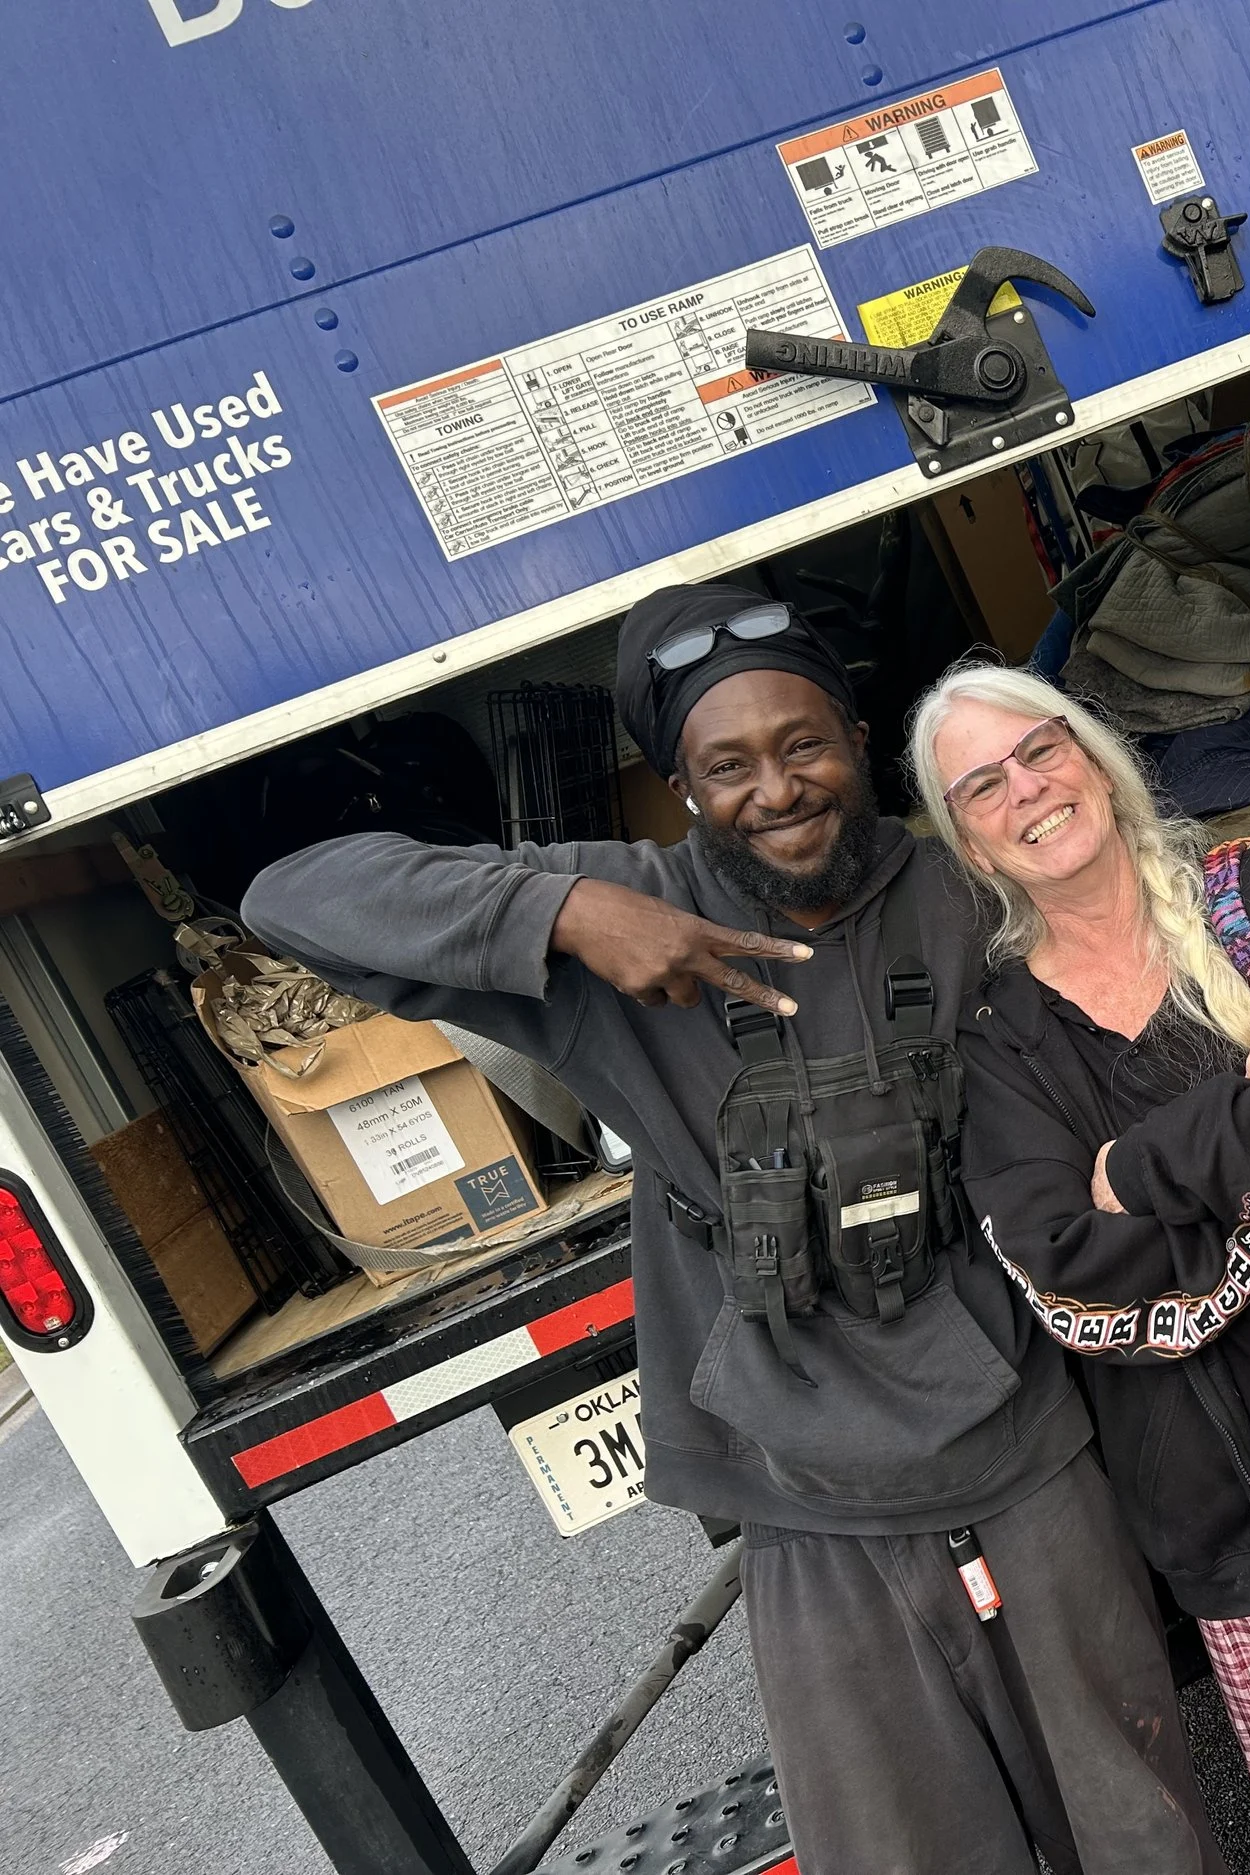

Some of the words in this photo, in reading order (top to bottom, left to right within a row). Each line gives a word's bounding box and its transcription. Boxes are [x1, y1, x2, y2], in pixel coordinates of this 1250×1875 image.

[864, 92, 947, 133] WARNING
[971, 148, 983, 157] Use
[983, 144, 997, 153] grab
[996, 137, 1017, 148] handle
[1147, 134, 1184, 154] WARNING
[917, 166, 935, 177] Driving
[935, 162, 945, 170] with
[945, 158, 957, 166] door
[957, 155, 970, 163] open
[864, 184, 886, 196] Moving
[885, 178, 900, 187] Door
[925, 187, 940, 196] Close
[939, 183, 950, 191] and
[949, 179, 962, 188] latch
[961, 175, 974, 183] door
[872, 206, 887, 215] Stand
[886, 202, 898, 210] clear
[904, 193, 924, 205] opening
[817, 227, 828, 235] Pull
[828, 222, 843, 232] strap
[853, 212, 869, 222] break
[618, 316, 638, 332] TO
[639, 306, 666, 325] USE
[667, 292, 706, 314] RAMP
[713, 326, 736, 339] CLOSE
[585, 352, 603, 364] Open
[602, 347, 617, 356] Rear
[616, 341, 633, 351] Door
[775, 340, 905, 377] WHITING
[552, 362, 573, 375] OPEN
[593, 367, 614, 380] Follow
[614, 352, 655, 372] manufacturers
[558, 376, 581, 389] LOWER
[560, 385, 574, 395] LIFT
[574, 379, 592, 390] GATE
[596, 370, 629, 387] instructions
[741, 388, 758, 398] Avoid
[757, 380, 779, 392] Serious
[779, 374, 796, 386] Injury
[752, 400, 762, 408] not
[763, 396, 778, 404] move
[778, 389, 793, 399] truck
[792, 385, 805, 394] with
[805, 381, 821, 390] ramp
[569, 398, 600, 414] RELEASE
[611, 413, 623, 421] Pull
[623, 409, 633, 417] out
[633, 397, 668, 414] completely
[745, 411, 753, 419] or
[753, 402, 779, 416] unlocked
[755, 425, 764, 433] Do
[764, 422, 774, 430] not
[773, 415, 793, 426] exceed
[793, 410, 807, 419] 1000
[806, 407, 816, 415] lbs.
[824, 400, 839, 410] ramp
[434, 412, 484, 437] TOWING
[578, 422, 597, 433] PULL
[0, 479, 15, 513] e
[16, 431, 151, 500] Have
[151, 371, 283, 449] Used
[587, 440, 608, 452] HOOK
[595, 457, 620, 470] CHECK
[646, 467, 662, 476] level
[661, 459, 685, 472] ground
[603, 473, 634, 489] POSITION
[0, 512, 81, 570] ars
[86, 487, 134, 530] &
[126, 435, 292, 513] Trucks
[36, 536, 148, 604] FOR
[148, 487, 271, 564] SALE
[347, 1096, 375, 1112] 6100
[381, 1083, 405, 1097] TAN
[354, 1112, 390, 1131] 48mm
[388, 1106, 399, 1116] X
[398, 1095, 423, 1111] 50M
[387, 1126, 397, 1135] X
[396, 1133, 427, 1151] ROLLS
[467, 1163, 510, 1190] TRUE
[381, 1204, 443, 1235] www.itape.com
[525, 1436, 575, 1521] PERMANENT
